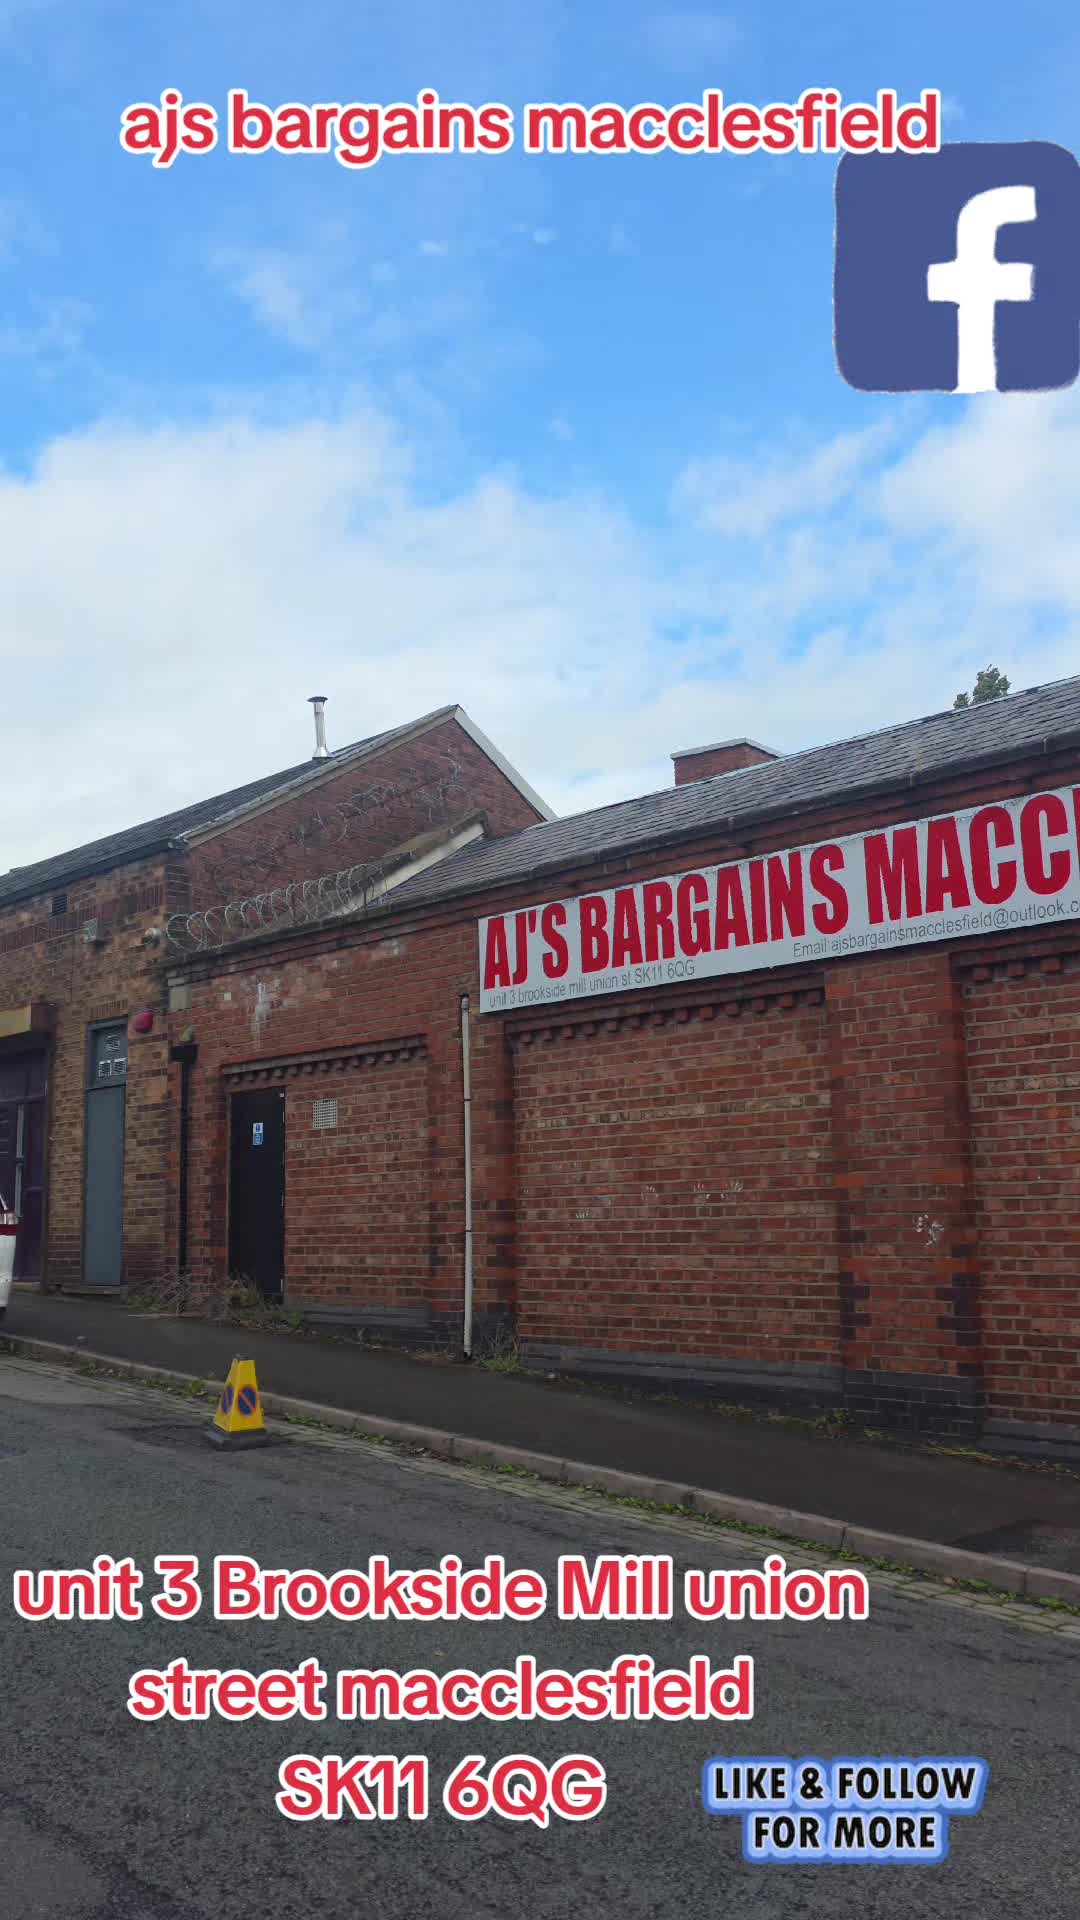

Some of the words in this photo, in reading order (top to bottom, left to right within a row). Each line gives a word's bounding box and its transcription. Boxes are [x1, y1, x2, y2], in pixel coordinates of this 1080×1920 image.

[485, 904, 569, 990] AJ'S
[579, 845, 849, 974] BARGAINS
[865, 787, 1080, 925] MACC
[489, 988, 507, 1008] unit
[509, 989, 516, 1004] 3
[518, 983, 566, 1003] brookside
[569, 977, 586, 995] mill
[589, 974, 618, 992] union
[621, 971, 631, 986] st
[634, 963, 662, 984] SK11
[667, 959, 695, 979] 6QG
